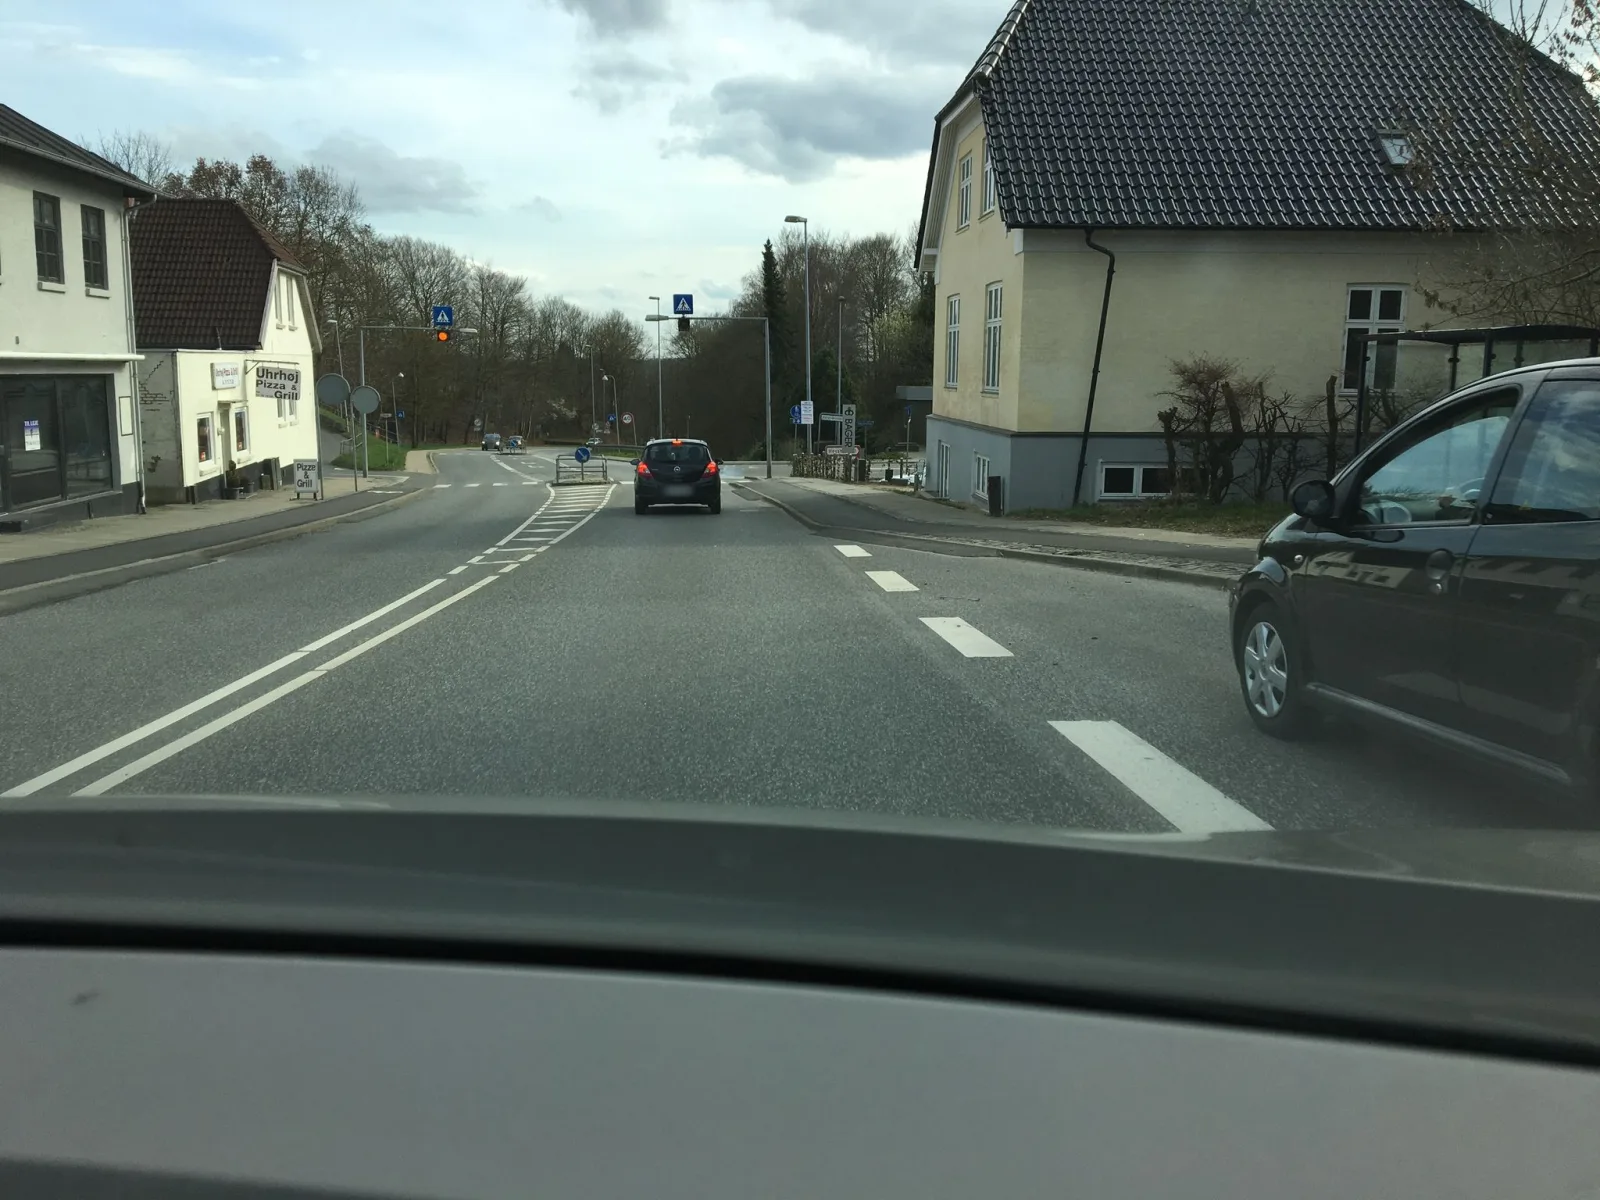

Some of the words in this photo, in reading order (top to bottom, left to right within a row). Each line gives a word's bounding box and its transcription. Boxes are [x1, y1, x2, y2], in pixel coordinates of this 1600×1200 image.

[256, 367, 299, 384] Uhrhøj
[256, 379, 286, 390] Pizza
[274, 390, 298, 400] Grill
[844, 418, 853, 448] BAGER
[304, 471, 309, 479] &
[297, 479, 313, 488] Grill
